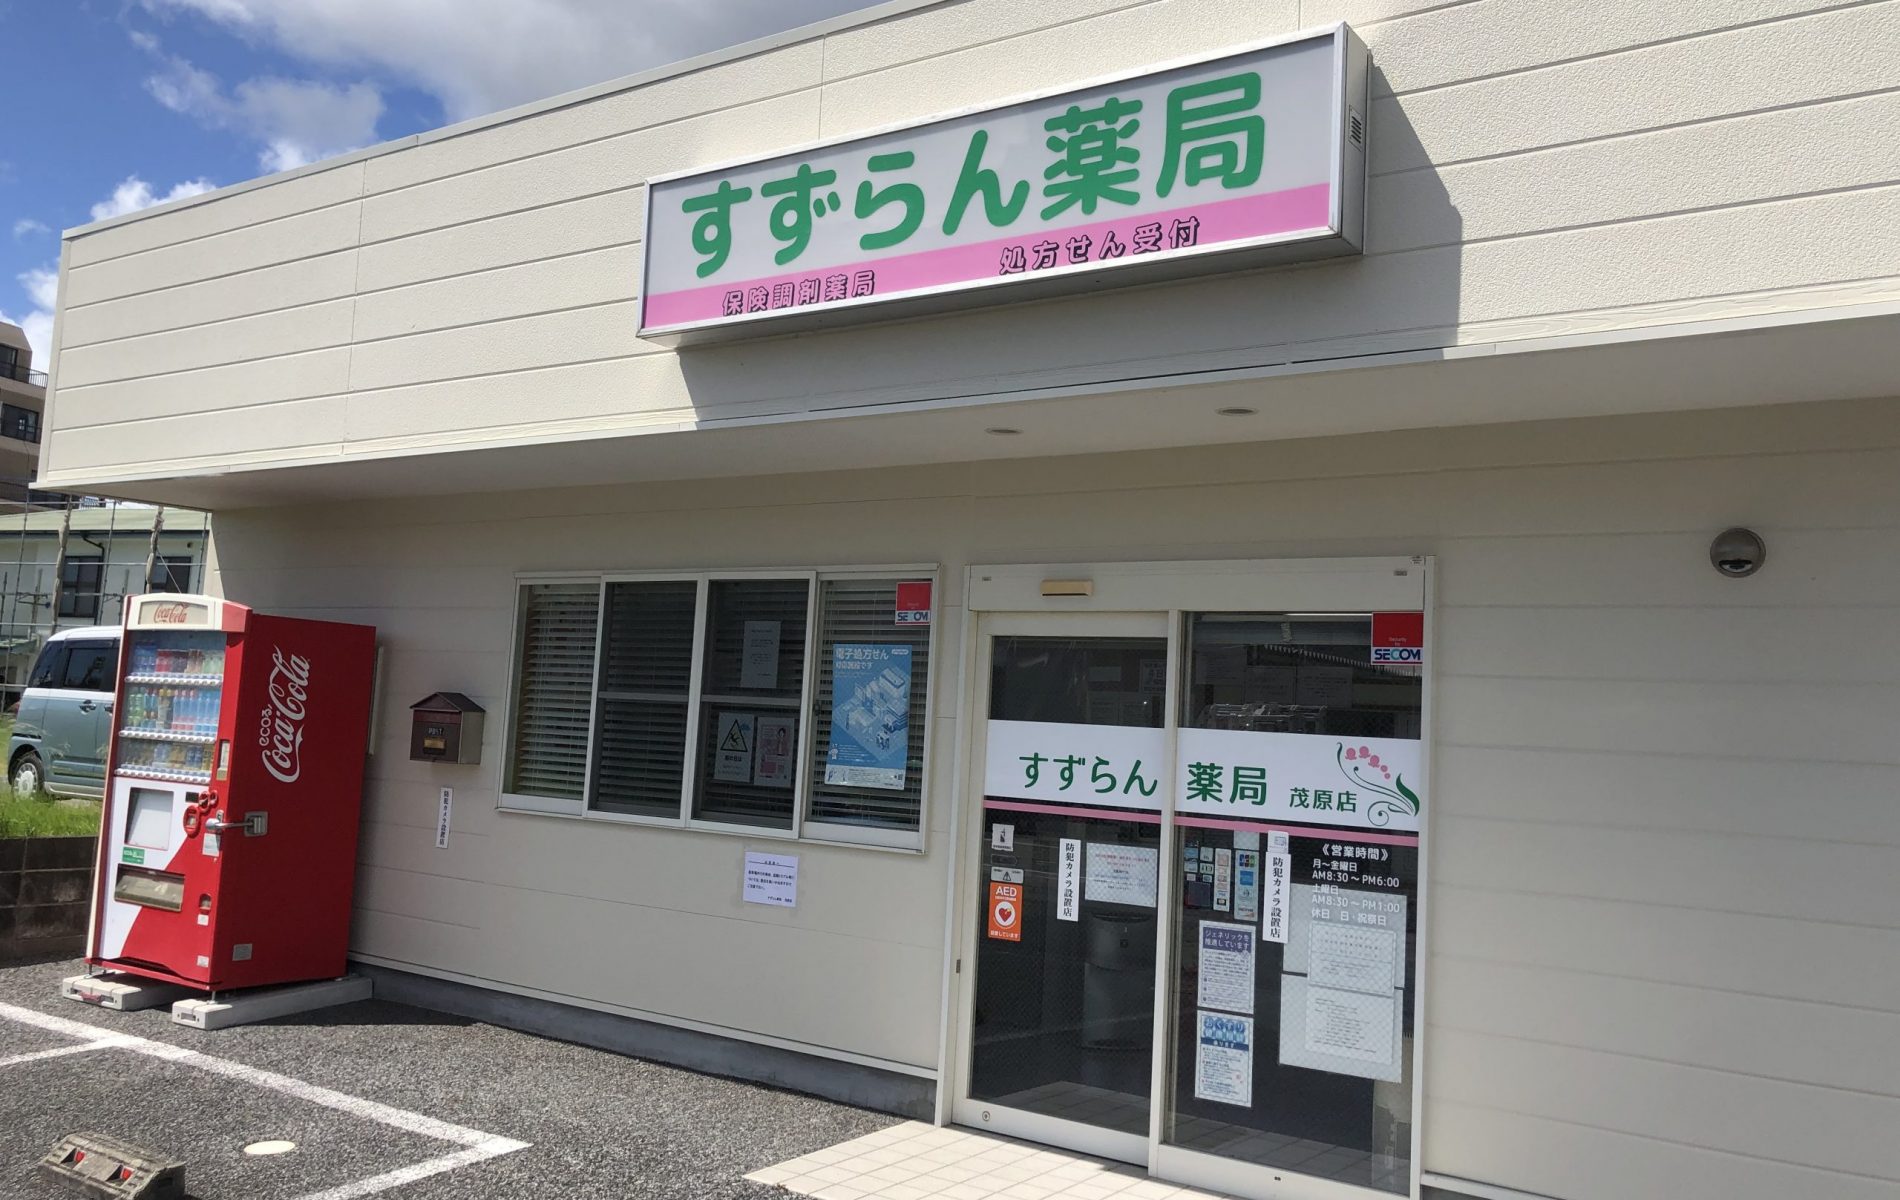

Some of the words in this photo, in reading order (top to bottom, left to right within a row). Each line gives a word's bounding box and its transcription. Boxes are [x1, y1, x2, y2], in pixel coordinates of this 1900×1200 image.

[682, 72, 1264, 278] すずらん薬局
[999, 216, 1200, 275] 処方せん受付
[722, 270, 875, 316] 保険調剤薬局
[897, 612, 928, 621] SEOM
[1374, 648, 1421, 661] SECOM
[1019, 752, 1158, 797] すずらん
[1186, 761, 1267, 806] 薬局
[1289, 787, 1357, 812] 茂原店
[1322, 843, 1389, 861] 《営業時間》
[1062, 842, 1075, 918] 防犯カメラ設置店
[1312, 883, 1339, 895] 土曜日
[995, 886, 1017, 897] AED
[1270, 857, 1283, 939] 防犯カメラ設置店
[1311, 908, 1330, 919] 休日
[1205, 929, 1250, 942] ジェネリックを
